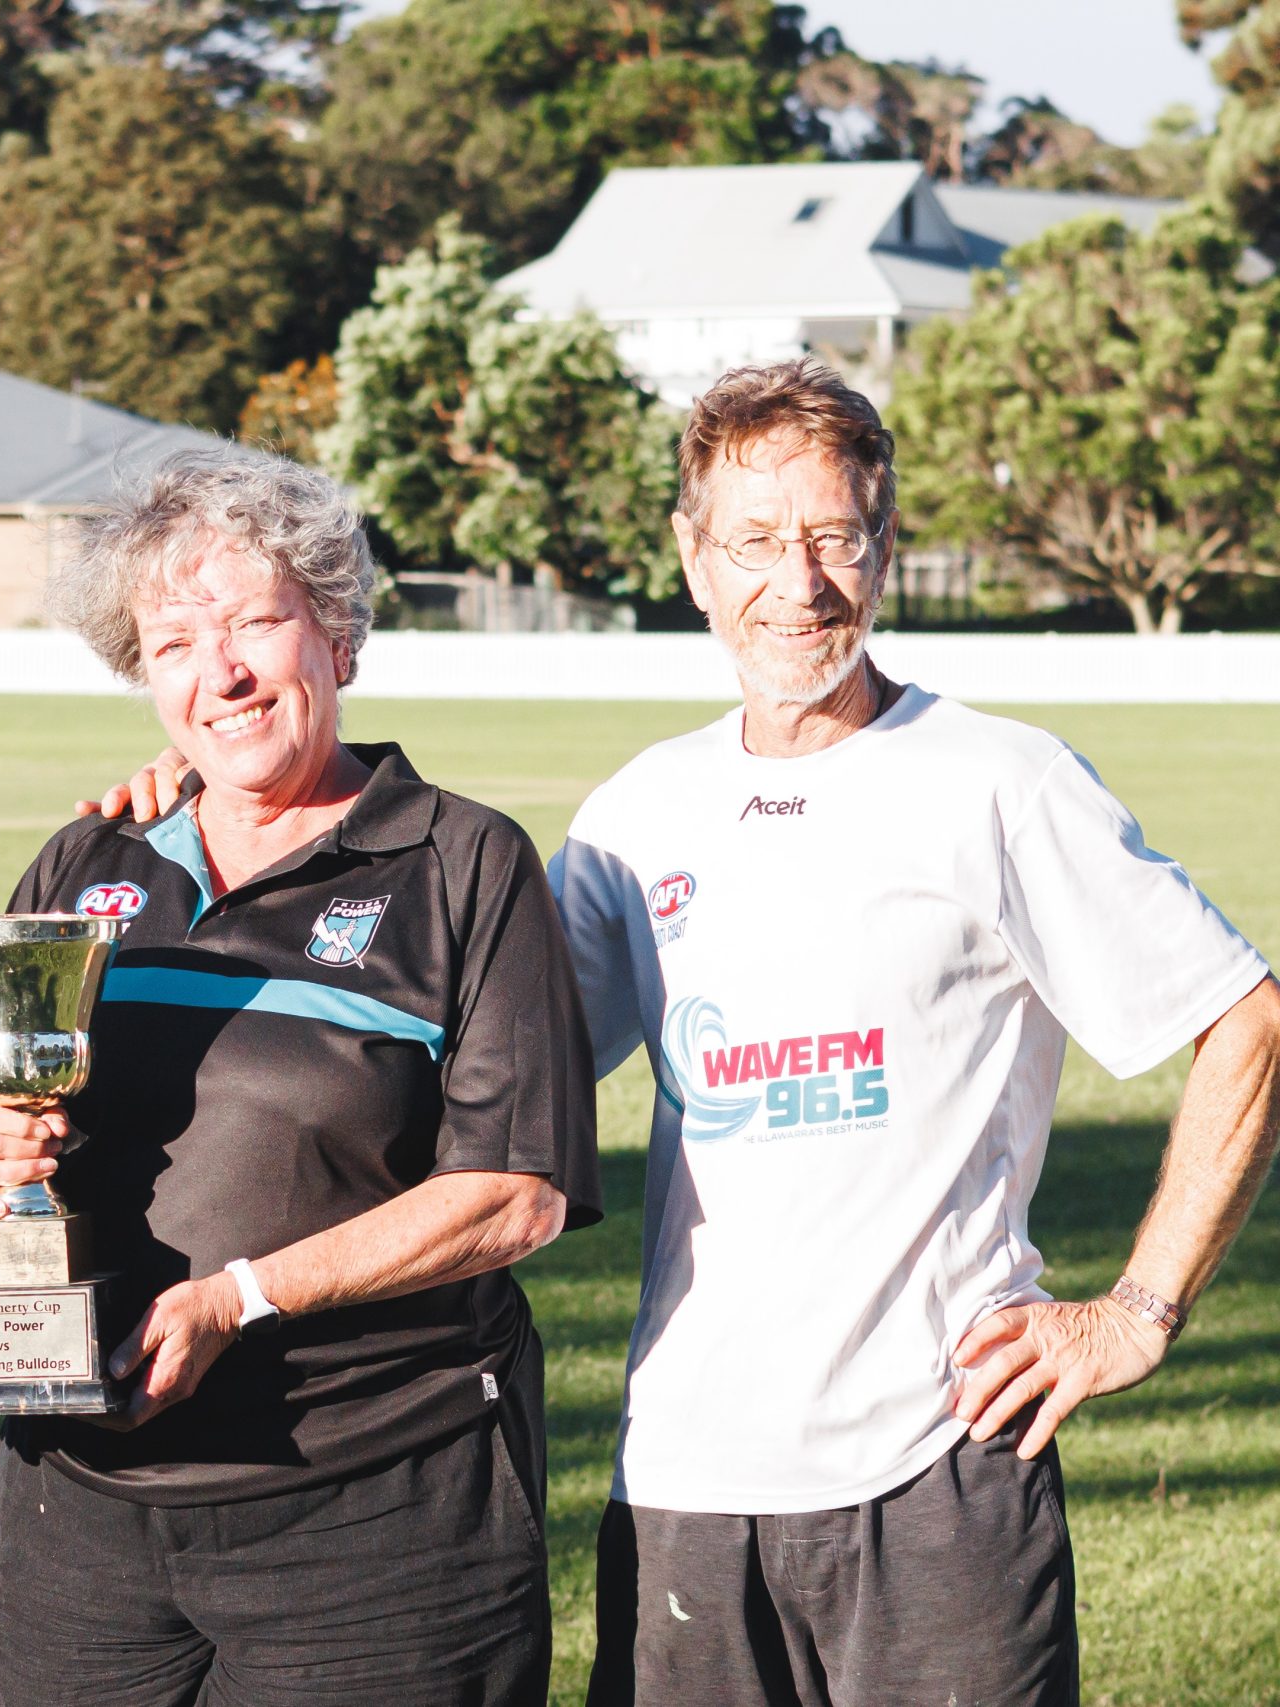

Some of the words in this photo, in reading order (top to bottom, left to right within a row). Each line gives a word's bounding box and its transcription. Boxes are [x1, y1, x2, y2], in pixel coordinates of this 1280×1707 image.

[738, 795, 807, 821] Aceit
[79, 889, 139, 913] AFL
[651, 879, 692, 913] AFL
[330, 904, 383, 918] POWER
[340, 900, 381, 909] KIAMA
[766, 1068, 889, 1129] 96.5
[826, 1124, 853, 1135] BEST
[855, 1119, 889, 1131] MUSIC
[33, 1300, 61, 1314] Cup
[4, 1320, 45, 1332] Power
[17, 1358, 71, 1371] Bulldogs
